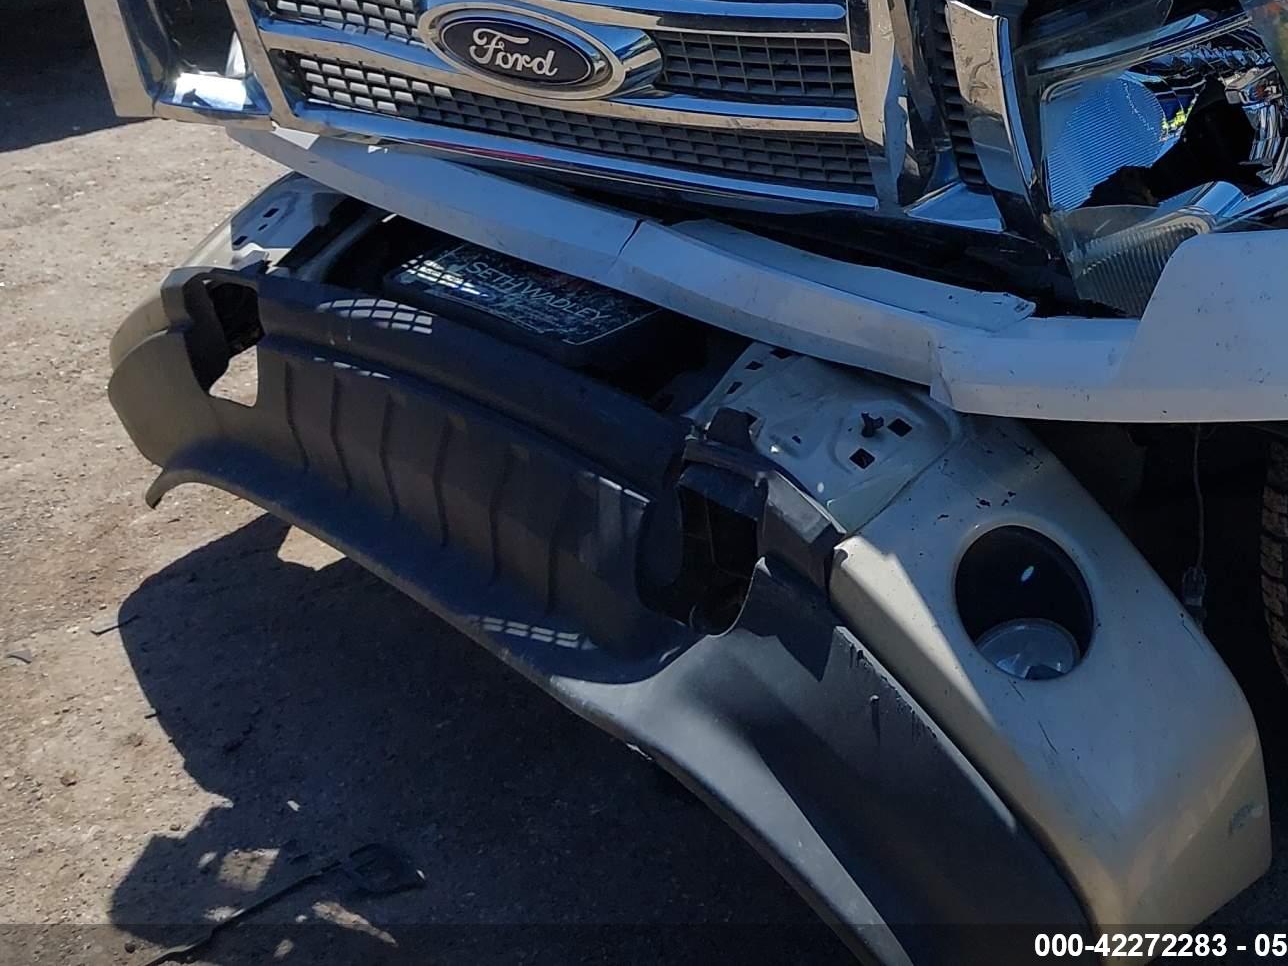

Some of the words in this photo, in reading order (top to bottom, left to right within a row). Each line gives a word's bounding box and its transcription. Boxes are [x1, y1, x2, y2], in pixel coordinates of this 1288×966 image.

[469, 27, 559, 77] Ford
[466, 261, 524, 293] SETH
[522, 282, 612, 321] WADLEY
